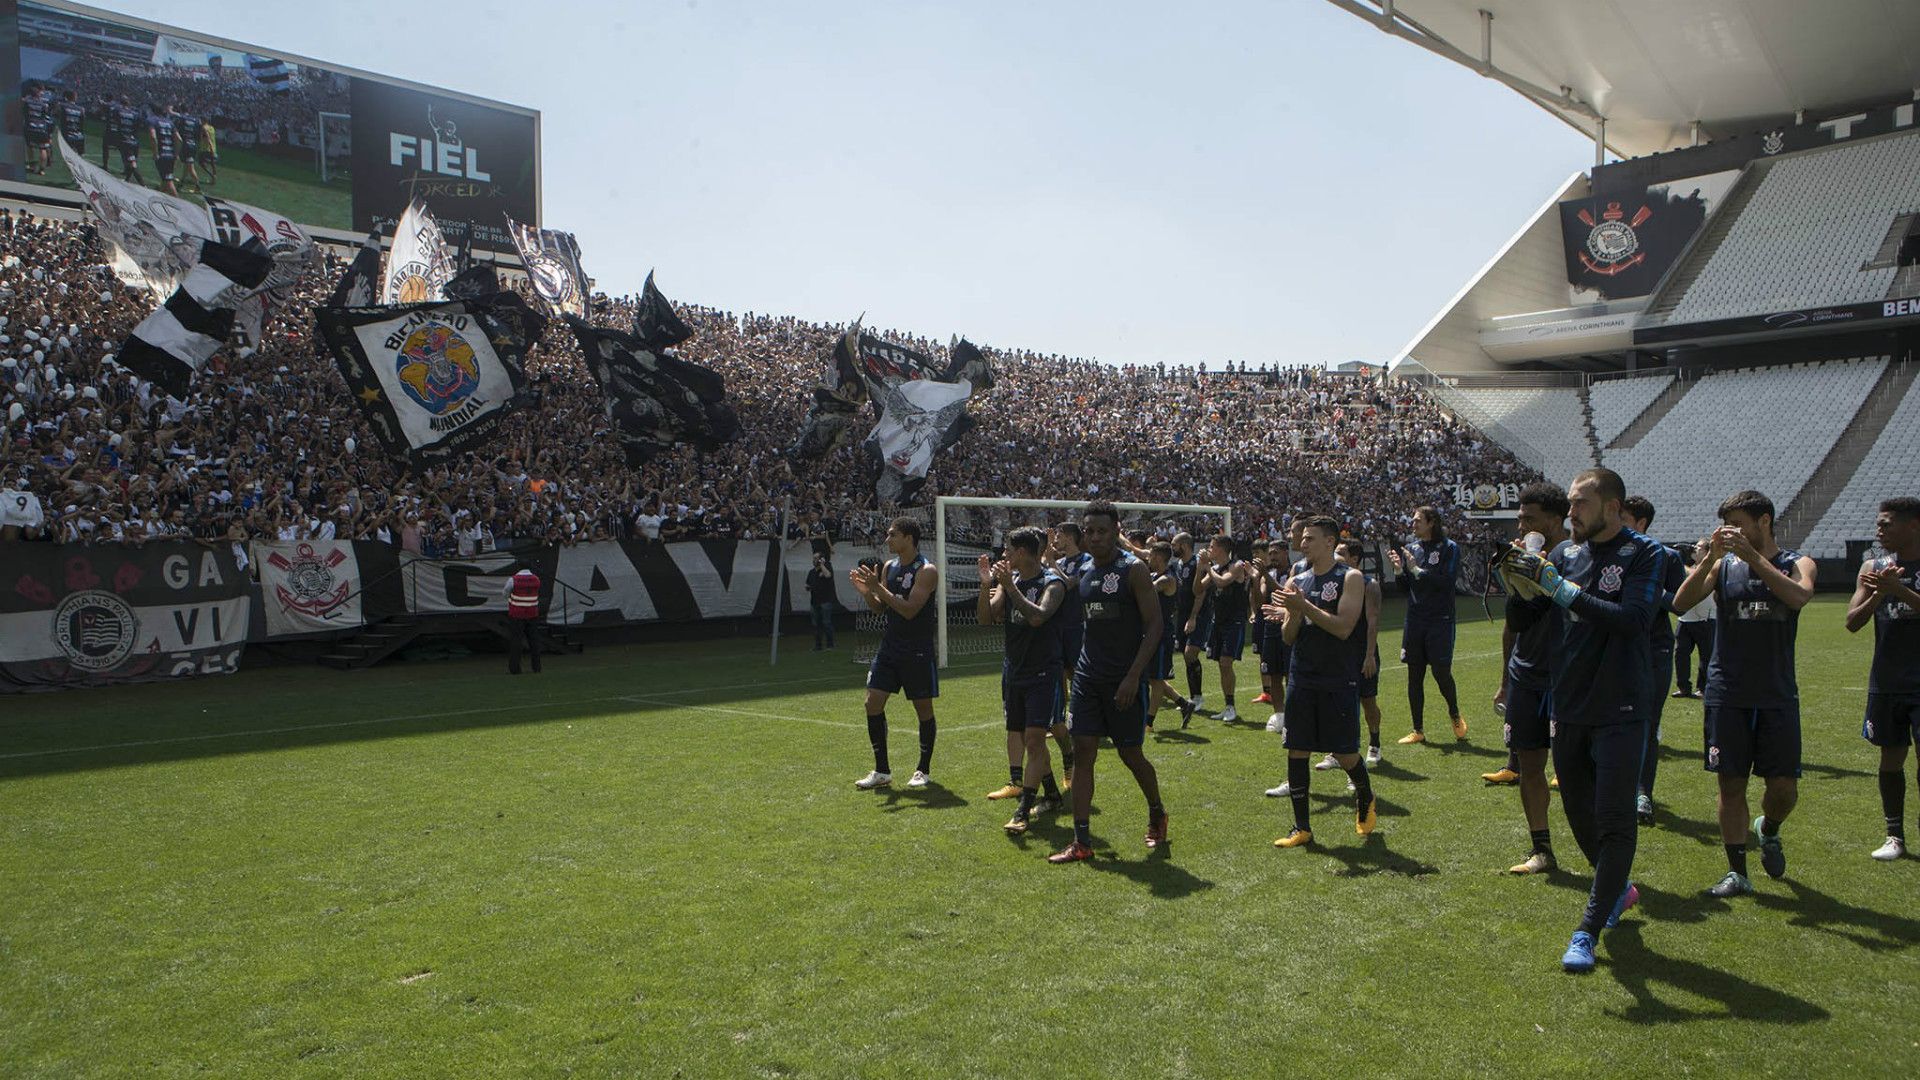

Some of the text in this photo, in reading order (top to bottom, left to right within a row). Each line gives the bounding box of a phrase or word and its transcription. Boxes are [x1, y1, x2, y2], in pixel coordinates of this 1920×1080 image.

[390, 132, 491, 182] FIEL
[1812, 312, 1853, 321] CORINTHIANS
[1579, 320, 1625, 331] CORINTHIANS
[16, 496, 27, 512] 9
[163, 551, 223, 590] GA
[1749, 601, 1769, 611] FIEL
[173, 606, 222, 646] VI
